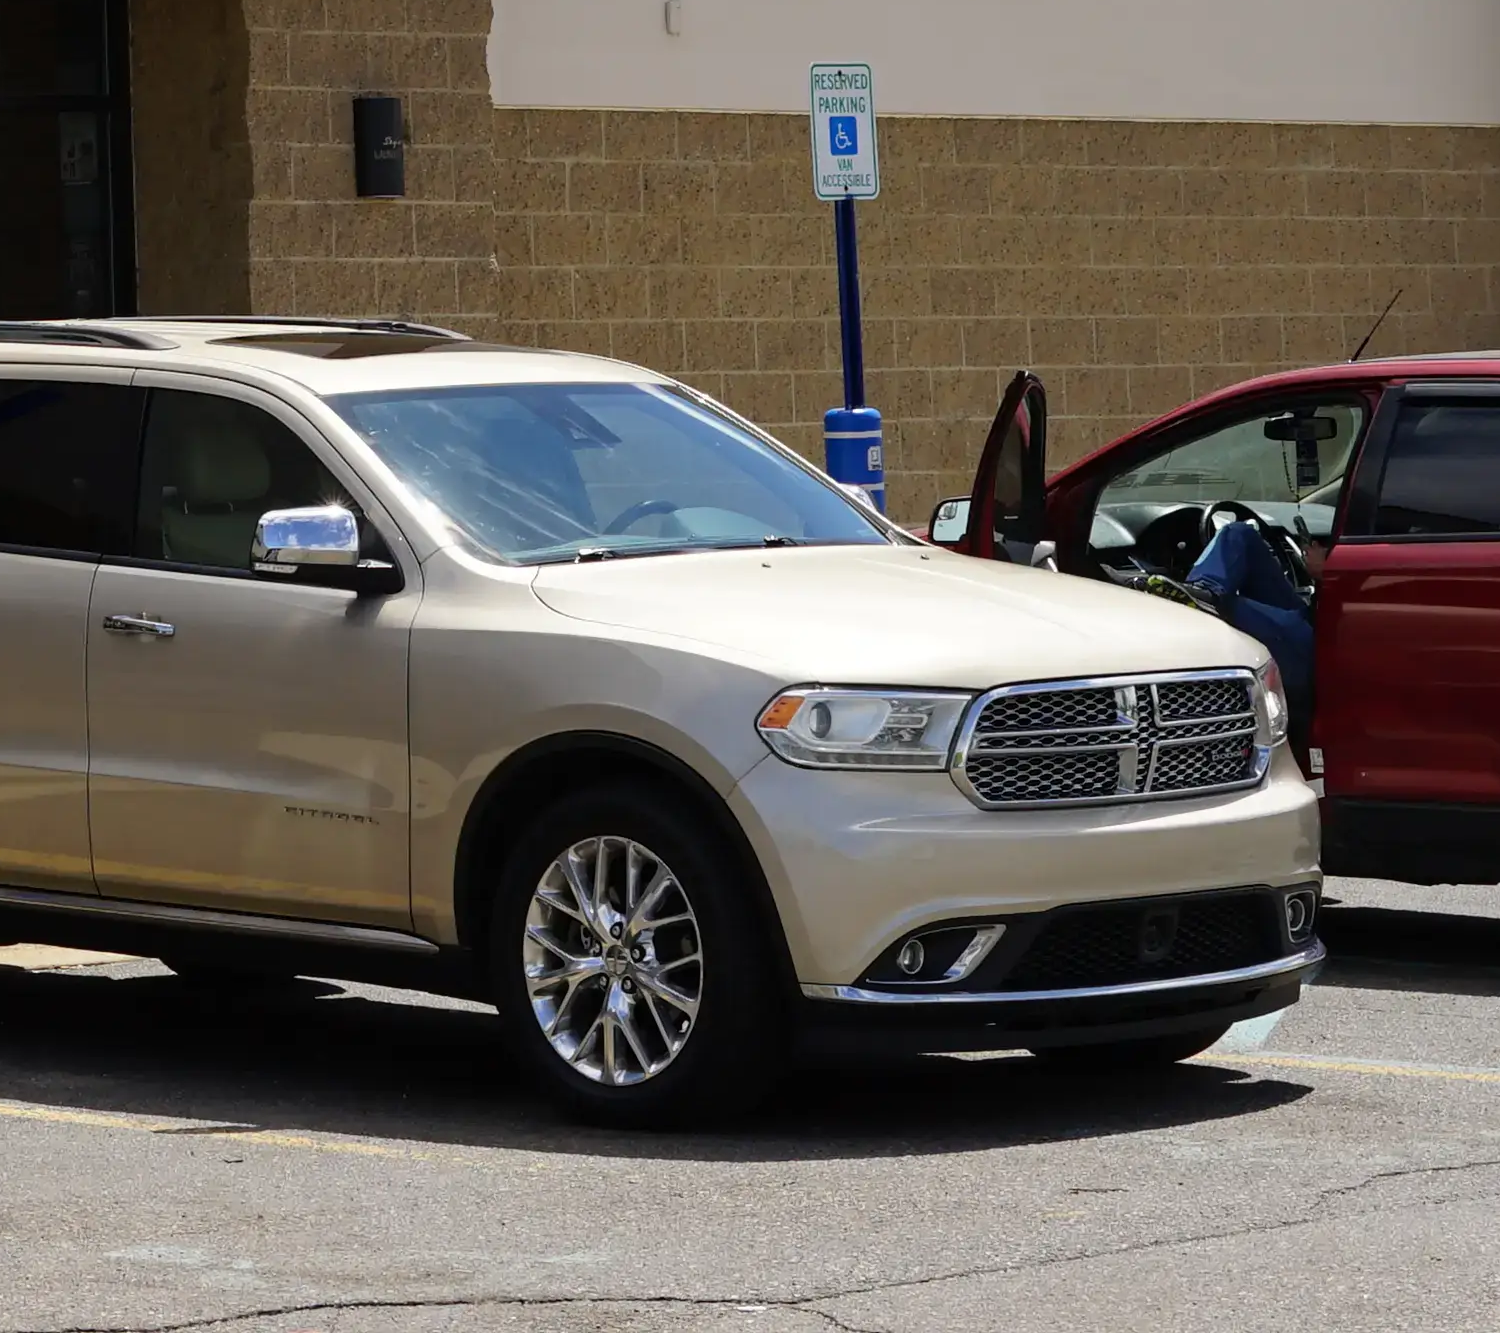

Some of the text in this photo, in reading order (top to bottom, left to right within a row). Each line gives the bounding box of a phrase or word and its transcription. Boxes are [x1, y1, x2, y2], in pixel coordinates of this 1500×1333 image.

[814, 73, 868, 90] RESERVED
[818, 97, 866, 113] PARKING
[837, 159, 853, 171] VAN
[822, 174, 871, 187] ACCESSIBLE
